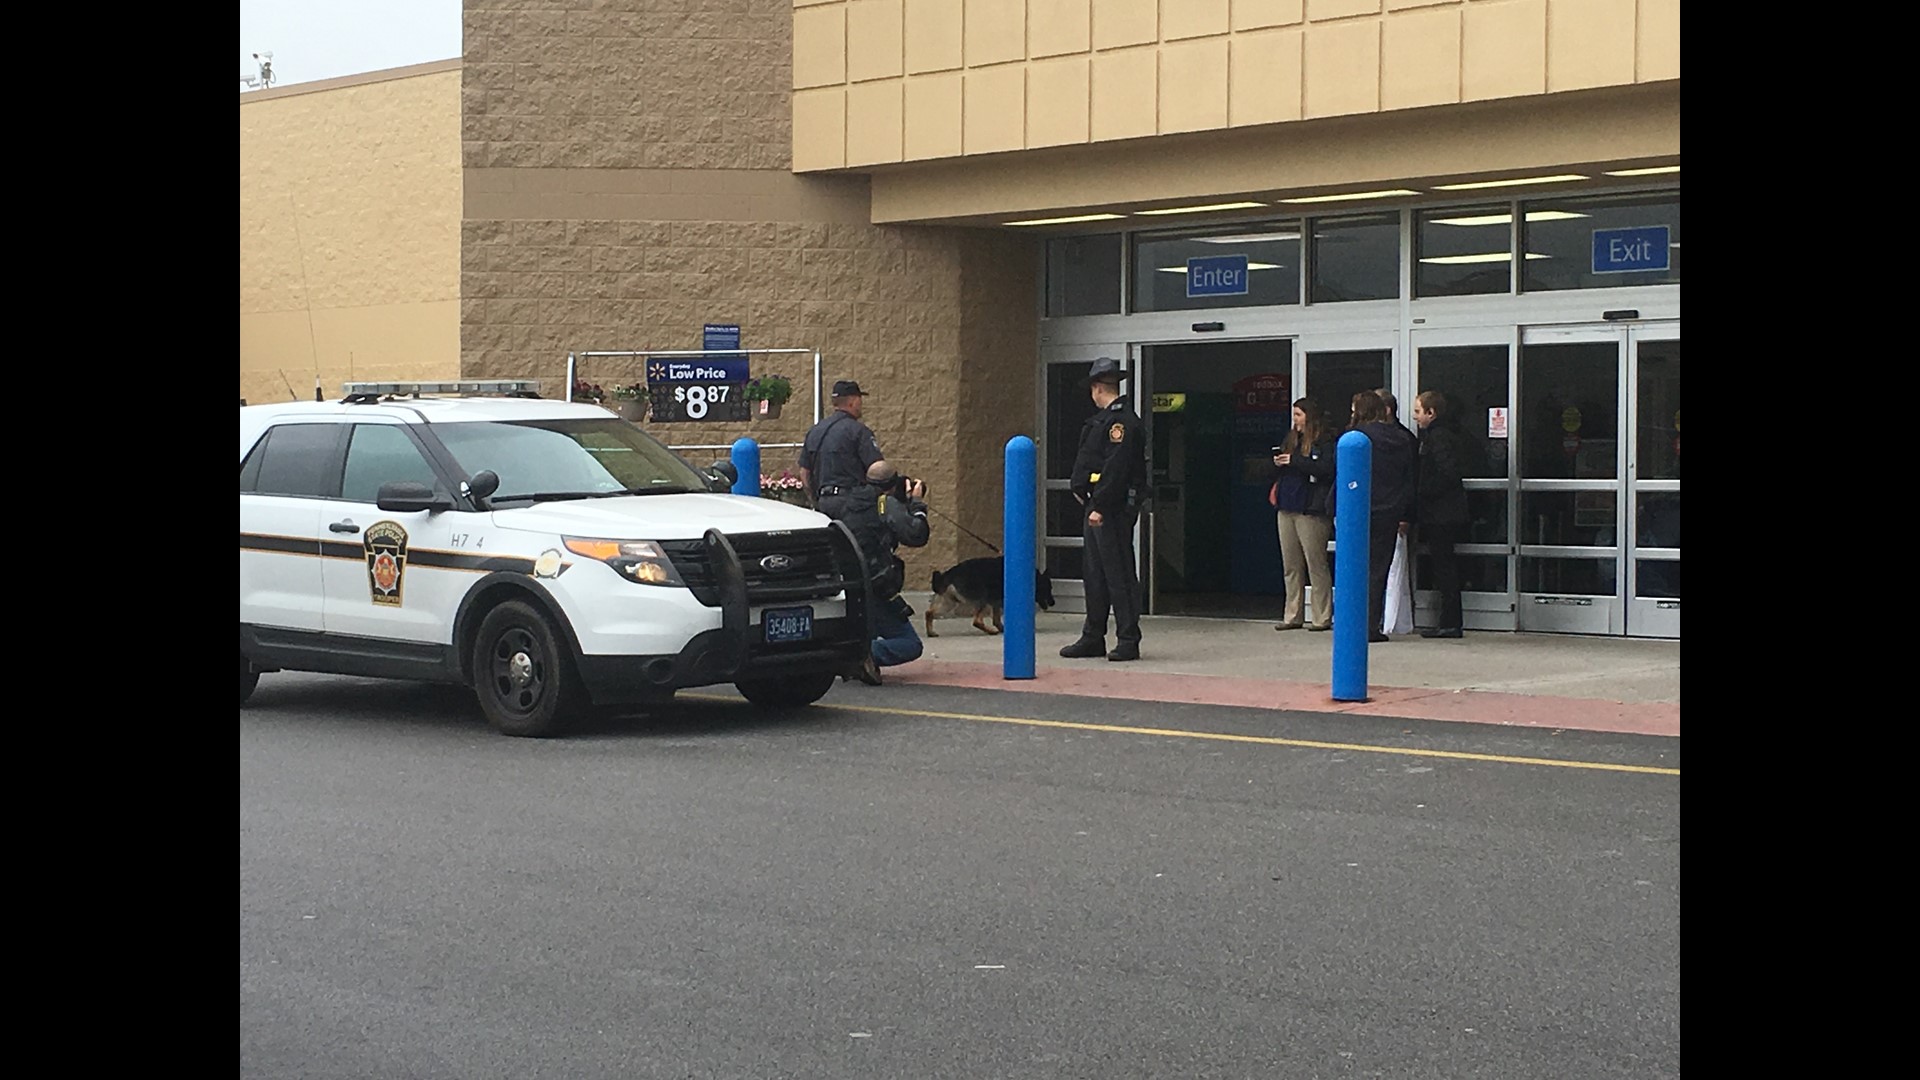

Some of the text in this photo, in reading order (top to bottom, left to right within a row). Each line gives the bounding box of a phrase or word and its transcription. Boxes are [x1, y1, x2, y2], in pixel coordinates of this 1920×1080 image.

[1609, 237, 1651, 262] Exit
[1193, 266, 1241, 288] Enter
[669, 367, 727, 379] Low Price
